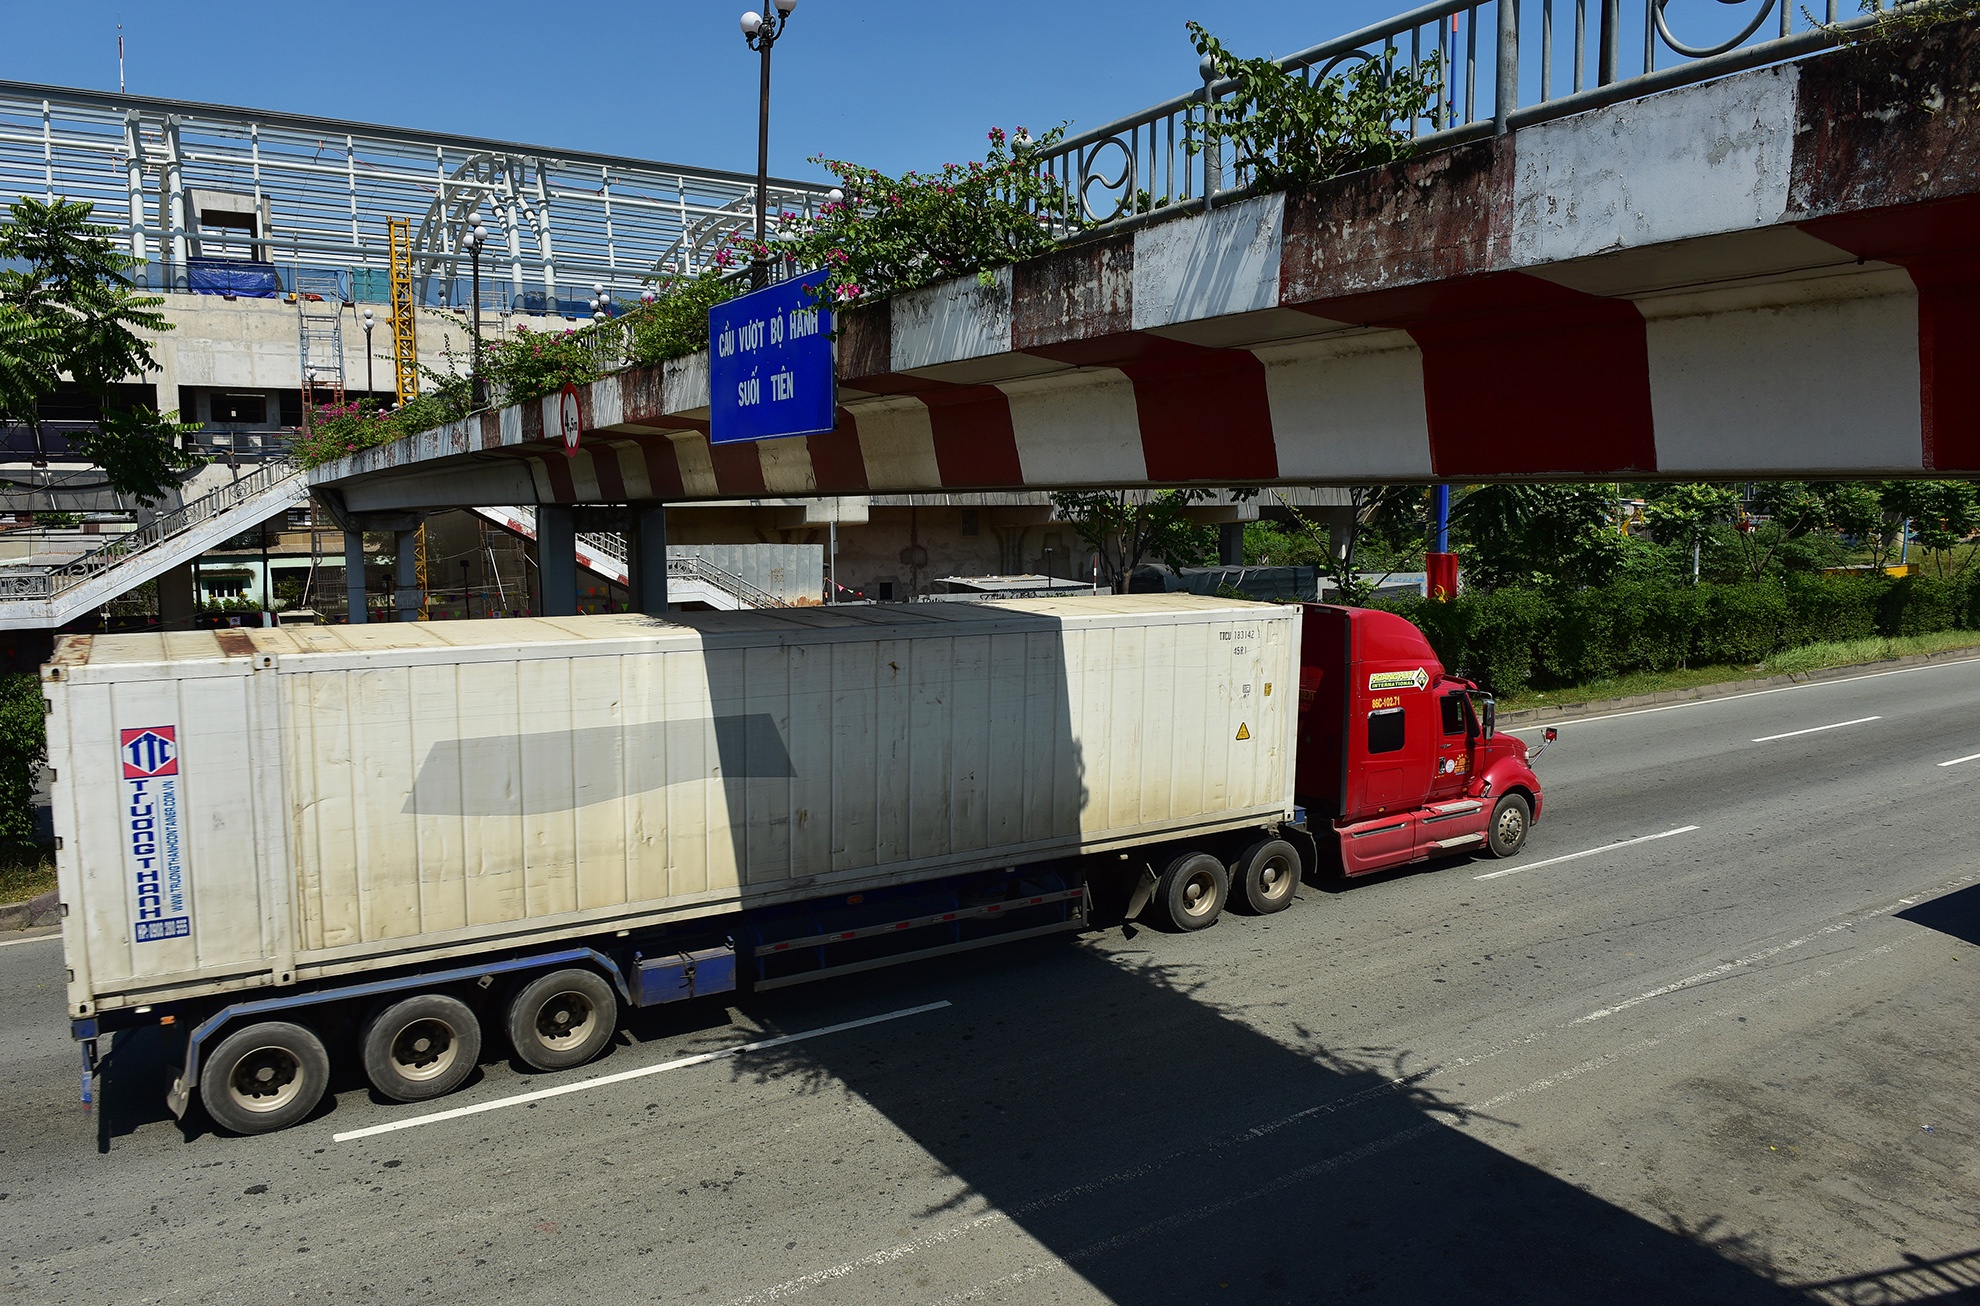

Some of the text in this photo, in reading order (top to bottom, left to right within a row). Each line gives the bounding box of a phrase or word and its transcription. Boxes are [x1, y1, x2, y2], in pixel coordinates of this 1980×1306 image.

[718, 301, 818, 358] CẦU VƯỢT BỘ HÀNH
[738, 365, 794, 407] SUỐI TIÊN
[129, 732, 171, 772] TTC
